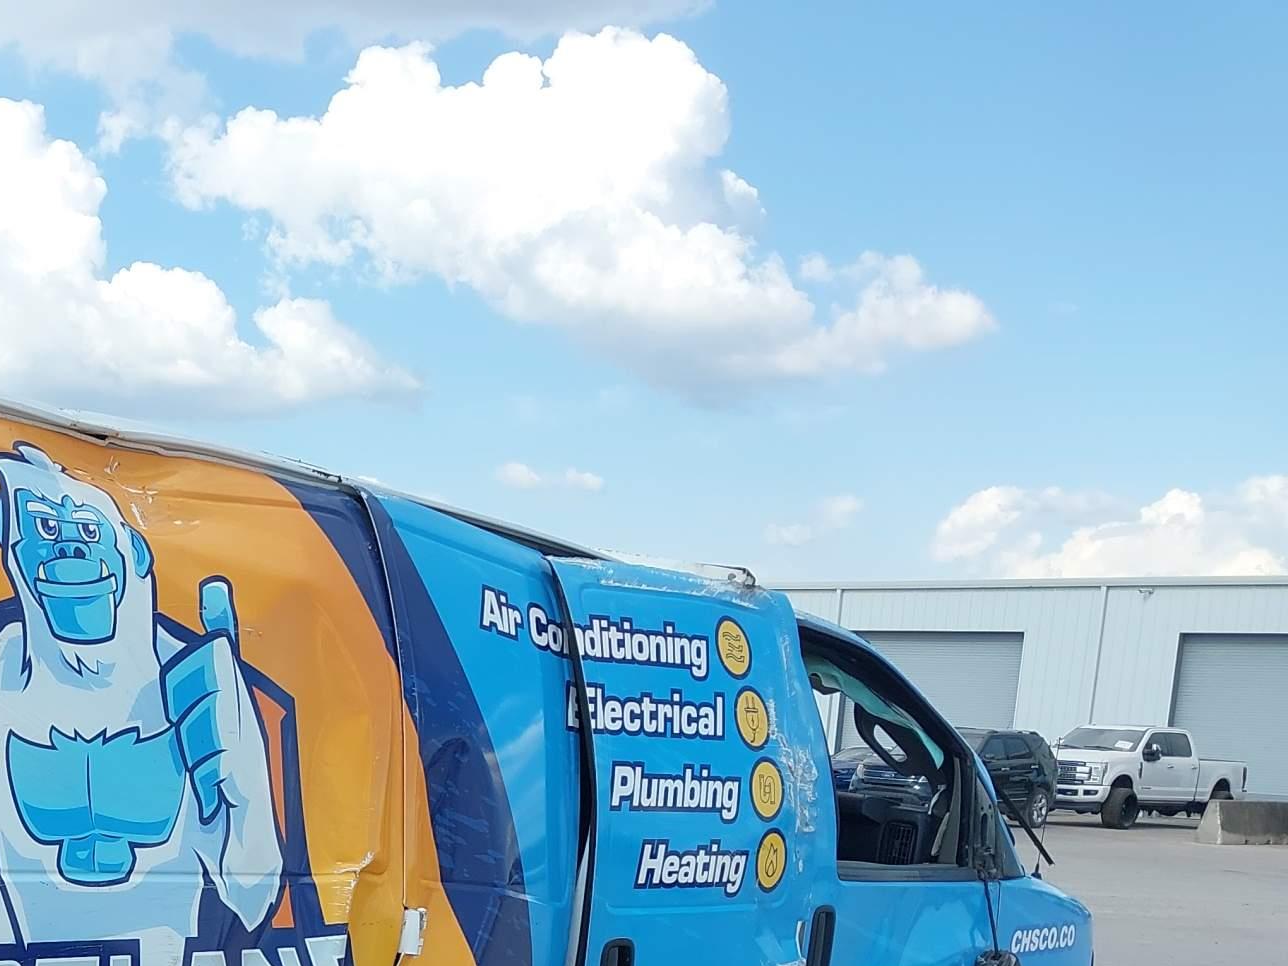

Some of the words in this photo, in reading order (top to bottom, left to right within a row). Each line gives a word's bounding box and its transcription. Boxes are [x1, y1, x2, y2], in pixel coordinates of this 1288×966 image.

[481, 589, 521, 635] Air
[528, 607, 708, 678] Conditioning
[611, 765, 739, 820] Plumbing
[637, 844, 747, 893] Heating
[1011, 924, 1076, 954] CHSCO.CO
